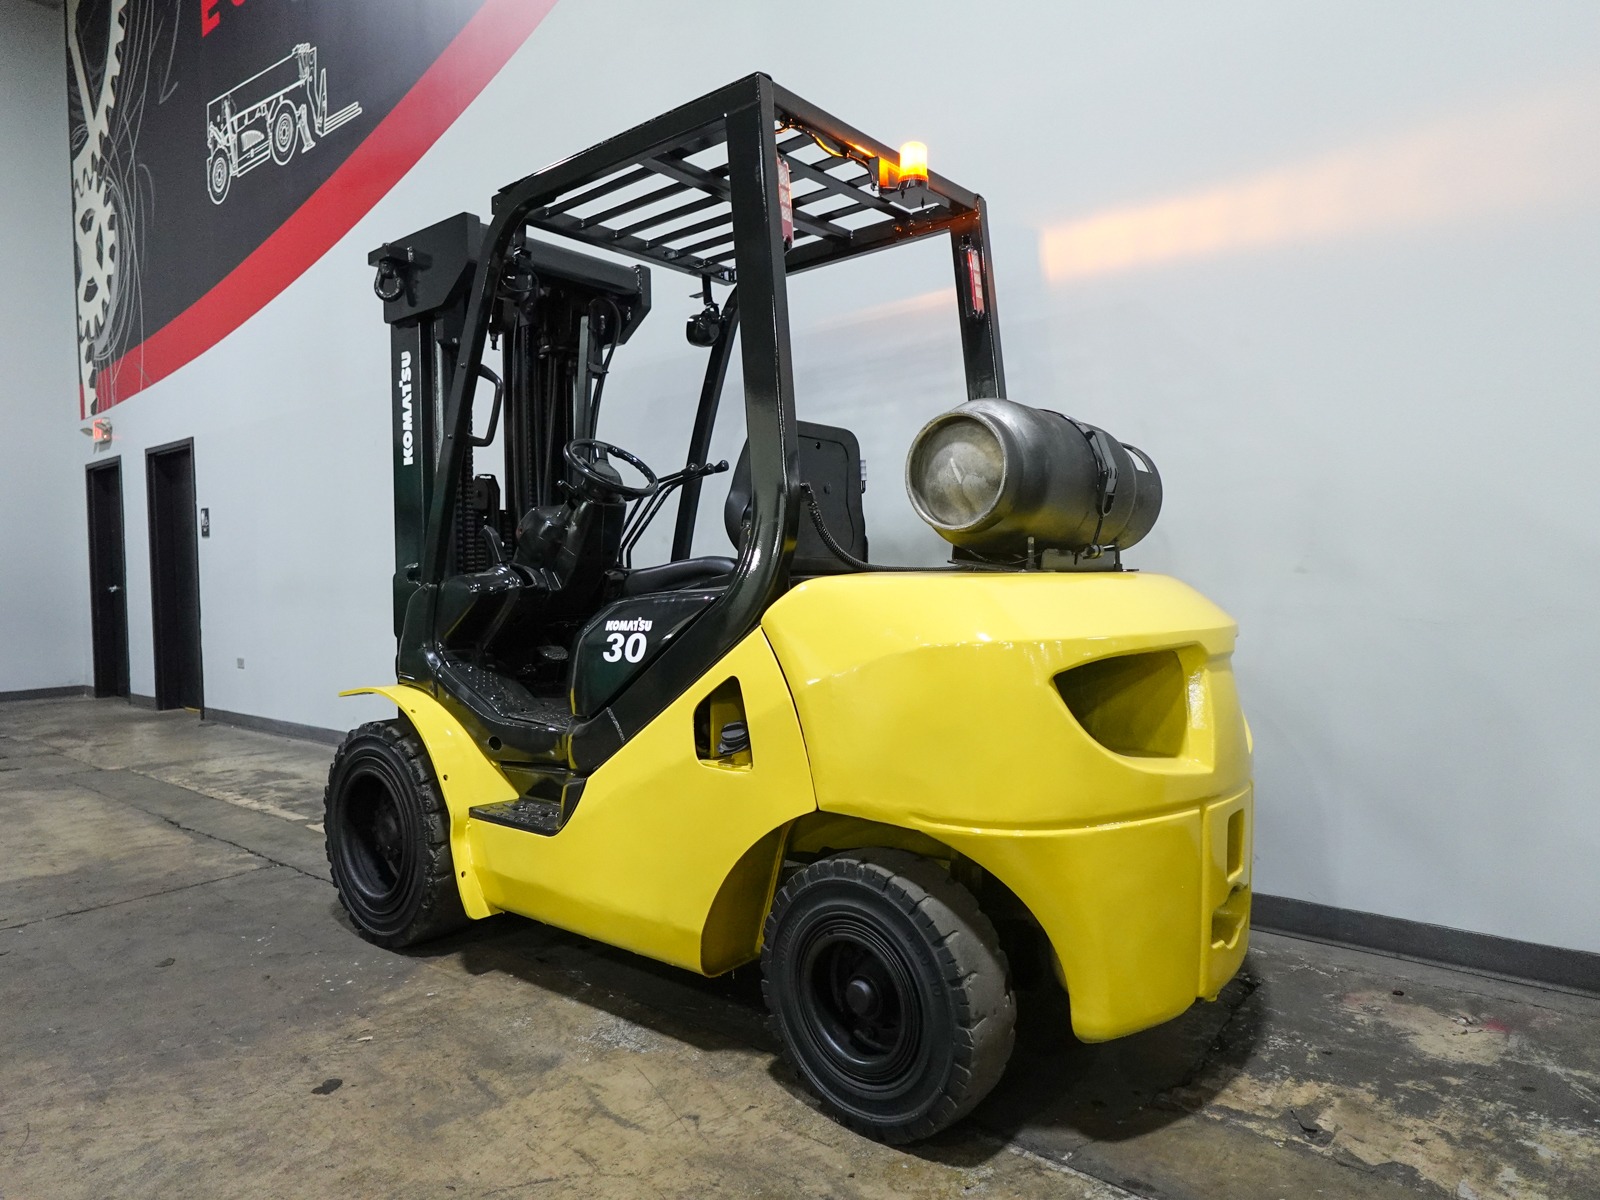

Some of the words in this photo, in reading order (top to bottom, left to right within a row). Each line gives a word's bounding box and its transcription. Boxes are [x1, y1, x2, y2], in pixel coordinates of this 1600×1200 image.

[399, 351, 413, 465] KOMATSU
[605, 617, 653, 631] KOMATSU
[603, 633, 647, 663] 30
